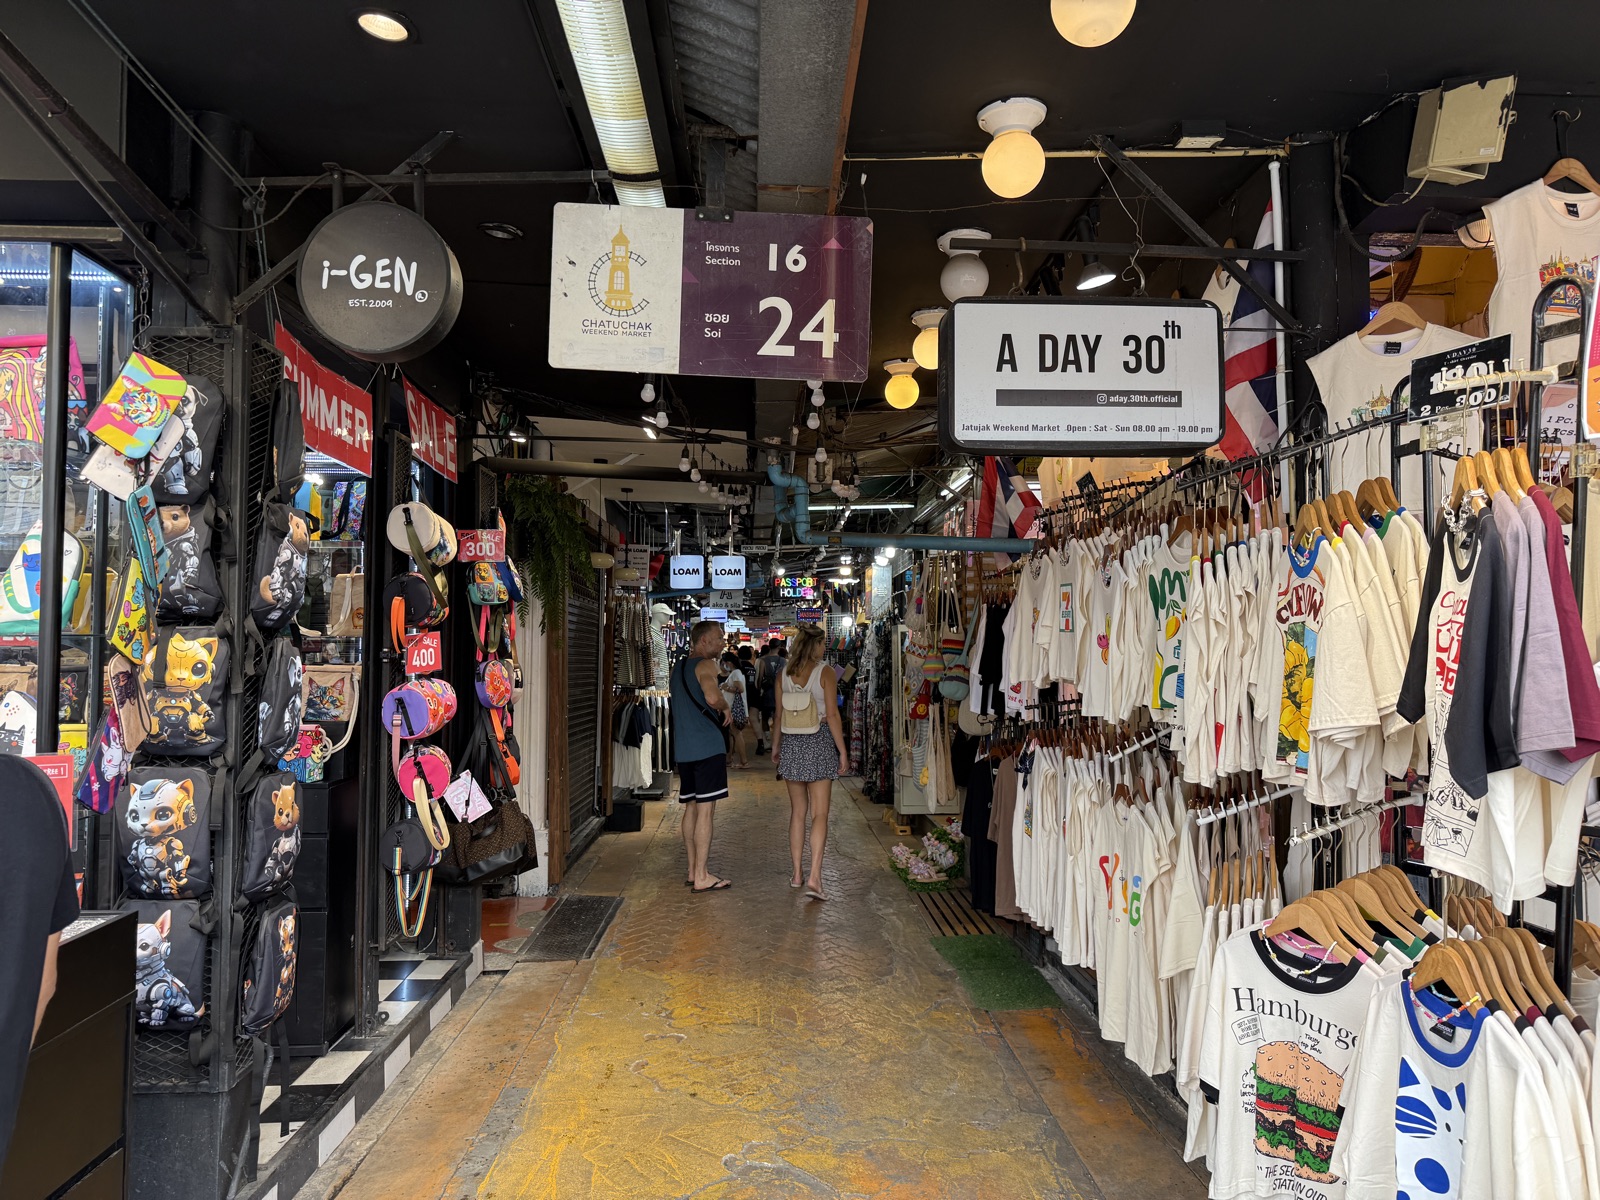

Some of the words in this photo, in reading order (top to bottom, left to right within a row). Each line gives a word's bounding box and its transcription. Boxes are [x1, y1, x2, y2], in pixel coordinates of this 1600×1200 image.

[706, 240, 740, 253] โครงการ
[705, 255, 741, 267] Section
[767, 243, 808, 273] 16
[321, 253, 418, 296] i-GEN
[348, 298, 393, 309] EST.2009
[704, 312, 731, 324] ซอย
[581, 318, 653, 331] CHATUCHAK
[756, 296, 840, 359] 24
[581, 328, 619, 336] WEEKEND
[704, 327, 722, 339] Soi
[996, 333, 1018, 373] A
[1038, 333, 1103, 374] DAY
[1108, 394, 1179, 405] aday.30th.official
[1420, 404, 1432, 417] 2
[1455, 387, 1497, 409] 300
[405, 386, 457, 473] SALE
[961, 423, 991, 433] Jatujak
[993, 423, 1030, 433] Weekend
[1031, 423, 1061, 433] Market
[1066, 424, 1087, 434] Open
[1093, 424, 1108, 433] Sat
[1115, 424, 1131, 433] Sun
[1132, 424, 1156, 433] 08.00
[1157, 425, 1170, 433] am
[1177, 424, 1199, 433] 19.00
[1200, 425, 1214, 435] pm
[482, 531, 502, 543] SALE
[465, 541, 496, 557] 300
[672, 568, 700, 576] LOAM
[714, 568, 742, 576] LOAM
[774, 577, 818, 587] PASSPORT
[780, 587, 814, 598] HOLDER
[422, 636, 438, 648] SALE
[412, 647, 436, 668] 400
[473, 792, 485, 812] SALE
